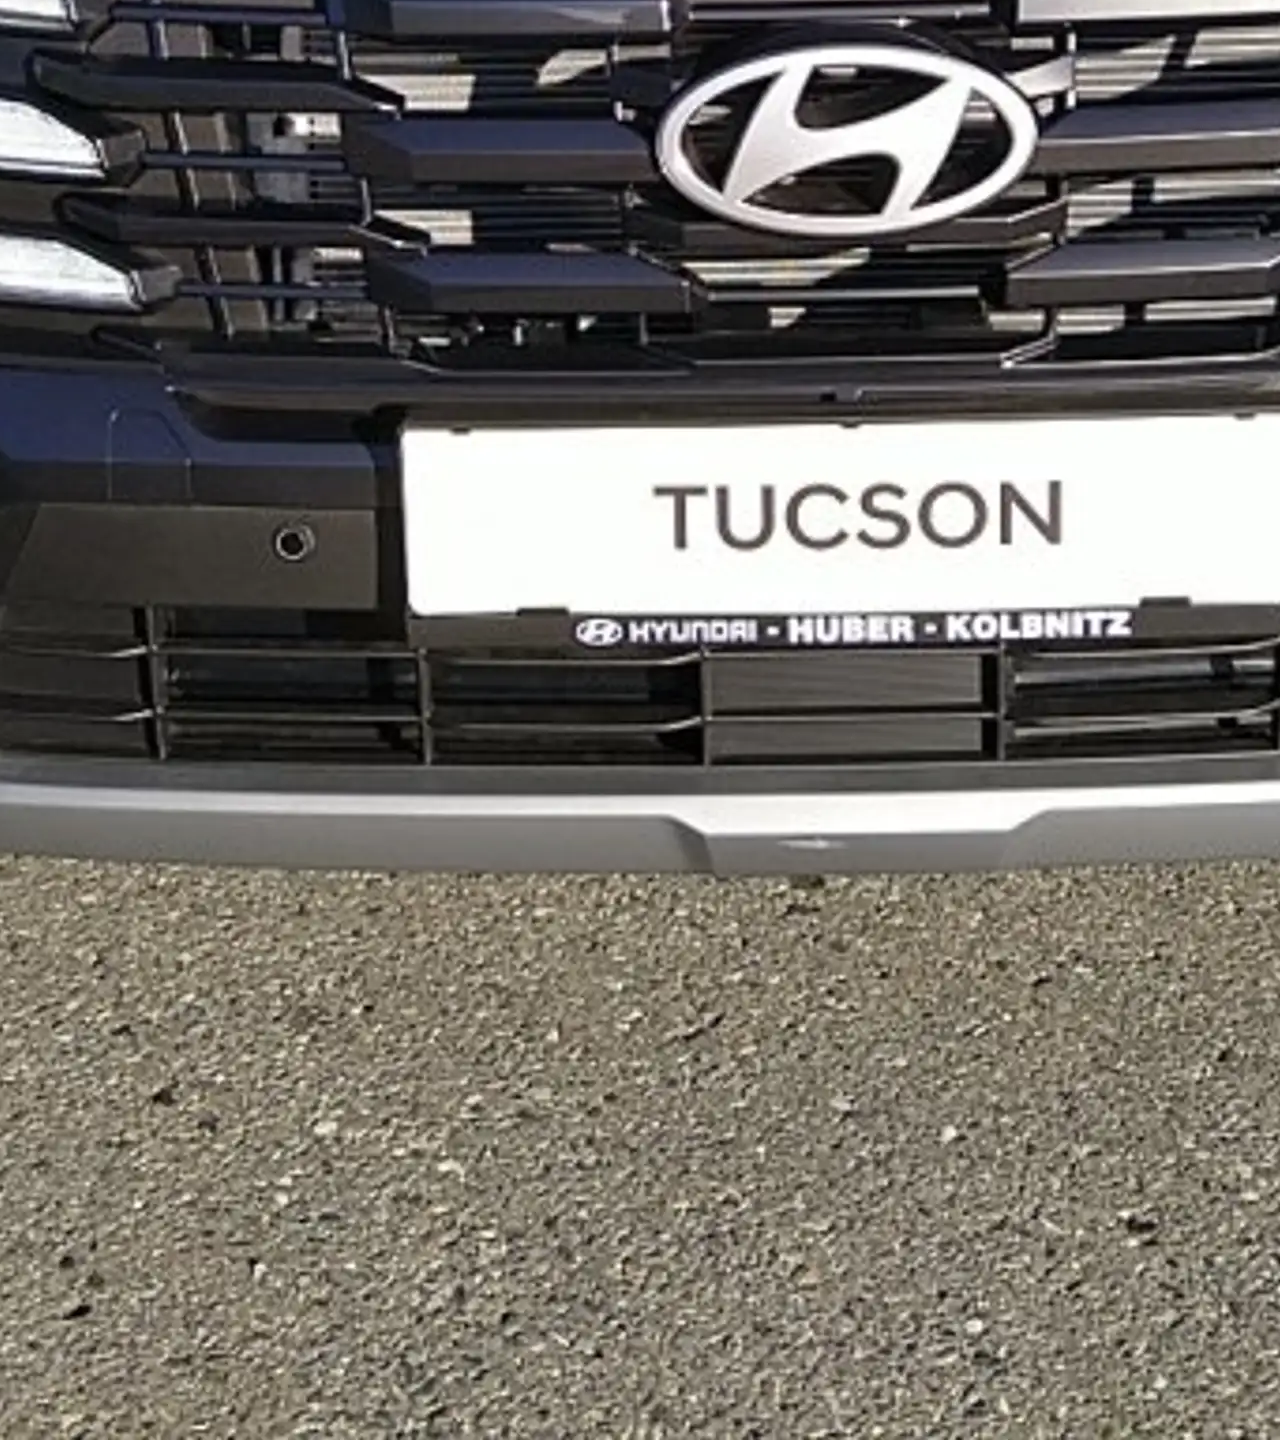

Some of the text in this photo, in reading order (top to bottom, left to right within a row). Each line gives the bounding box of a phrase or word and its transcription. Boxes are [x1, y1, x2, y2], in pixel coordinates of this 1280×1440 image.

[652, 480, 1062, 551] TUCSON
[628, 610, 1133, 644] HYUNDAI HUBER KOLBNITZ
